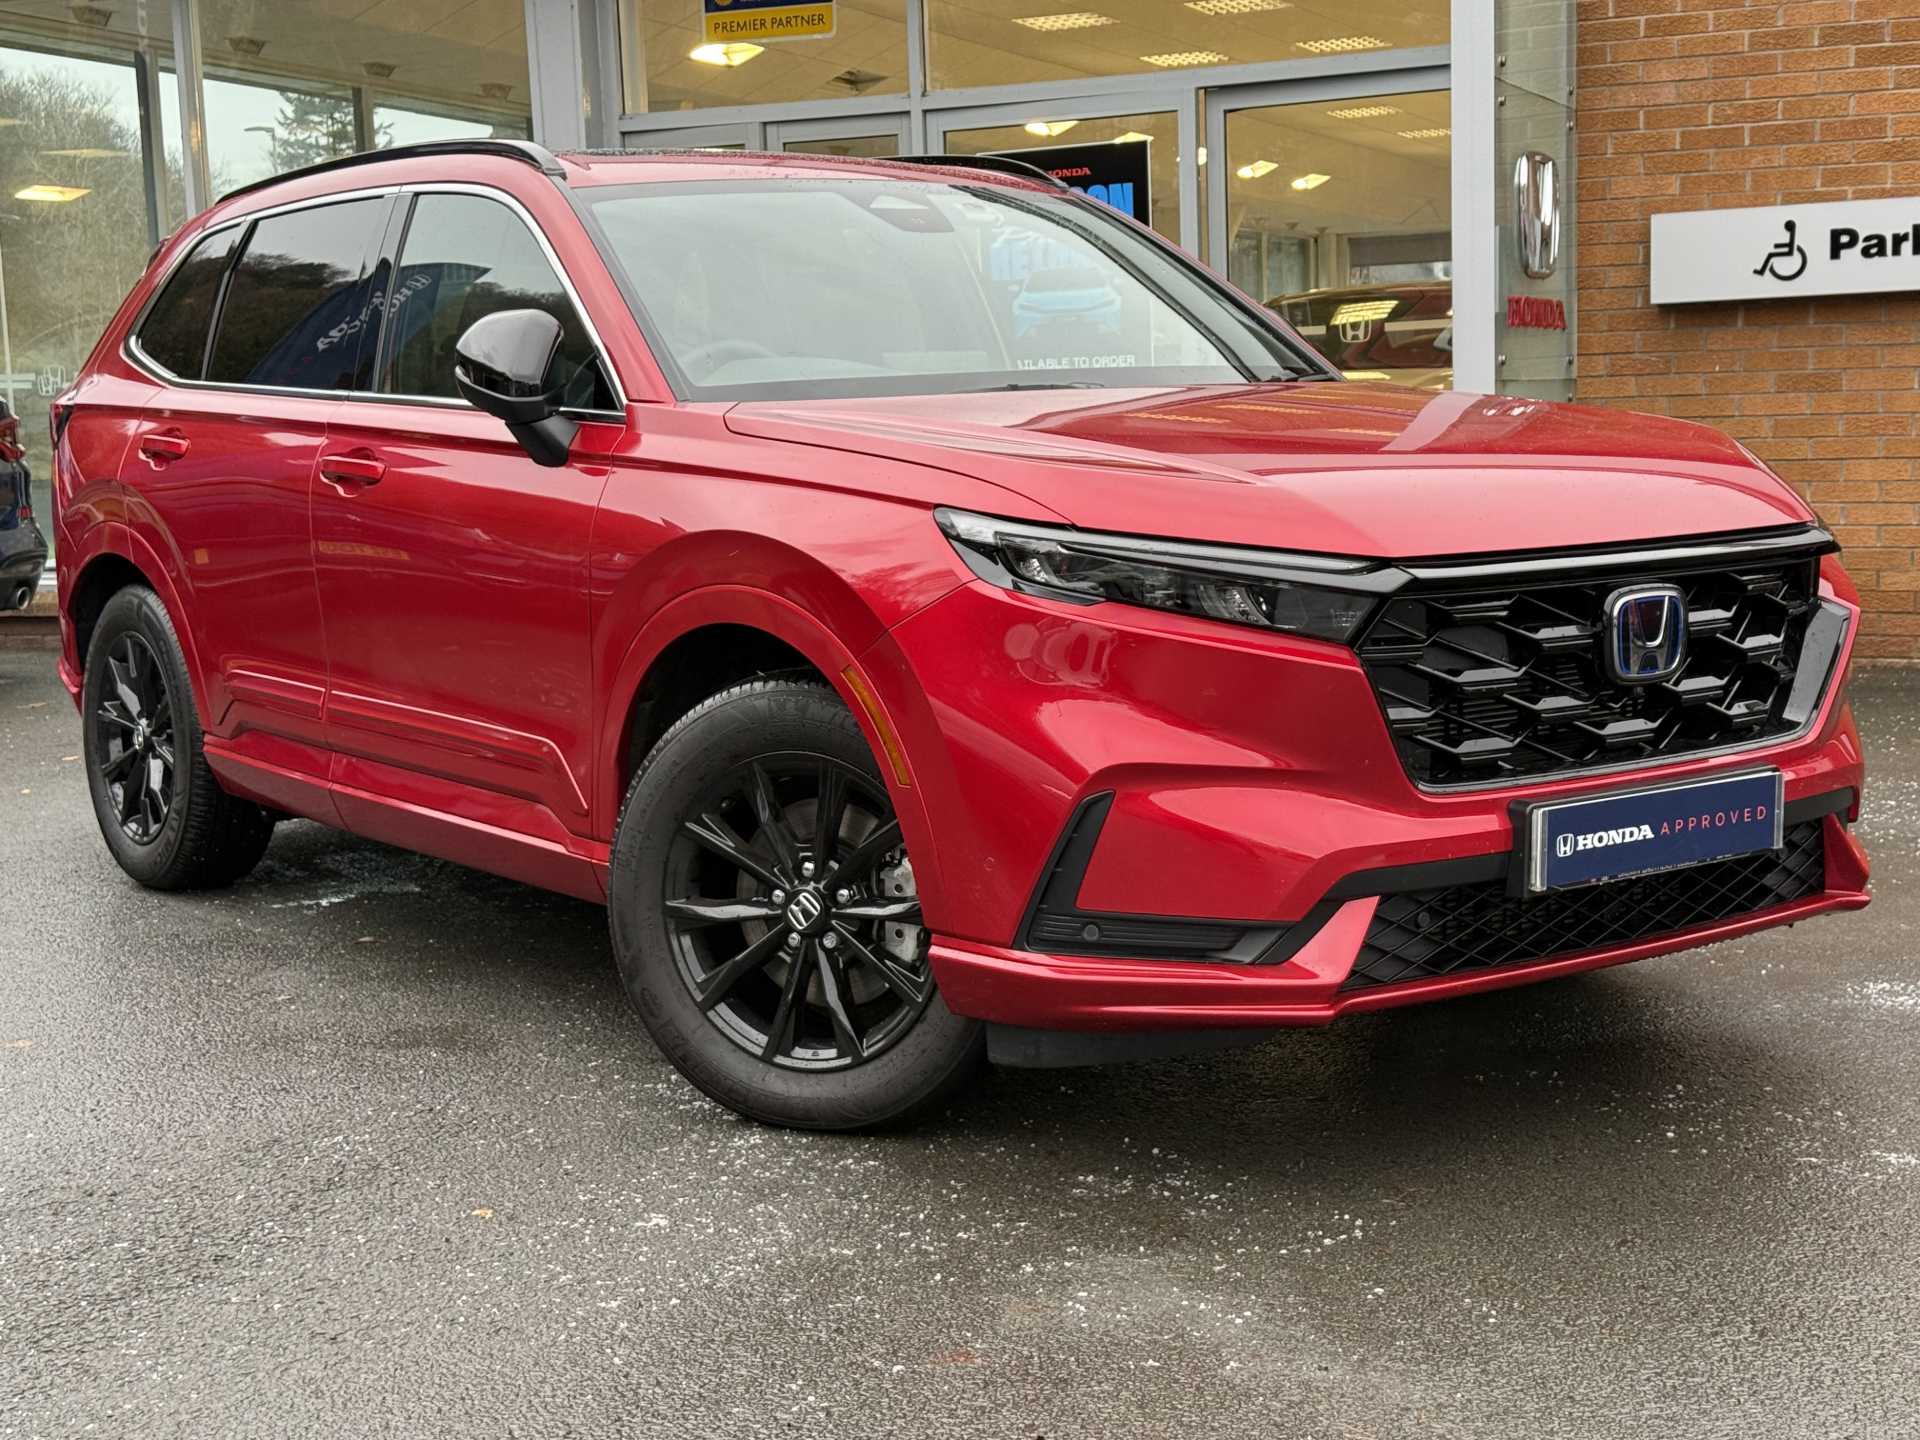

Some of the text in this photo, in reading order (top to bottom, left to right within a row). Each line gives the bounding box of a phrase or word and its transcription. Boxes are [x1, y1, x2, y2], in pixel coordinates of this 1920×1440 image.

[713, 13, 826, 33] PREMIER PARTNER
[1506, 295, 1568, 329] HONDA
[1072, 356, 1090, 369] TO
[1092, 354, 1136, 368] ORDER
[1576, 805, 1767, 851] HONDA APPROVED
